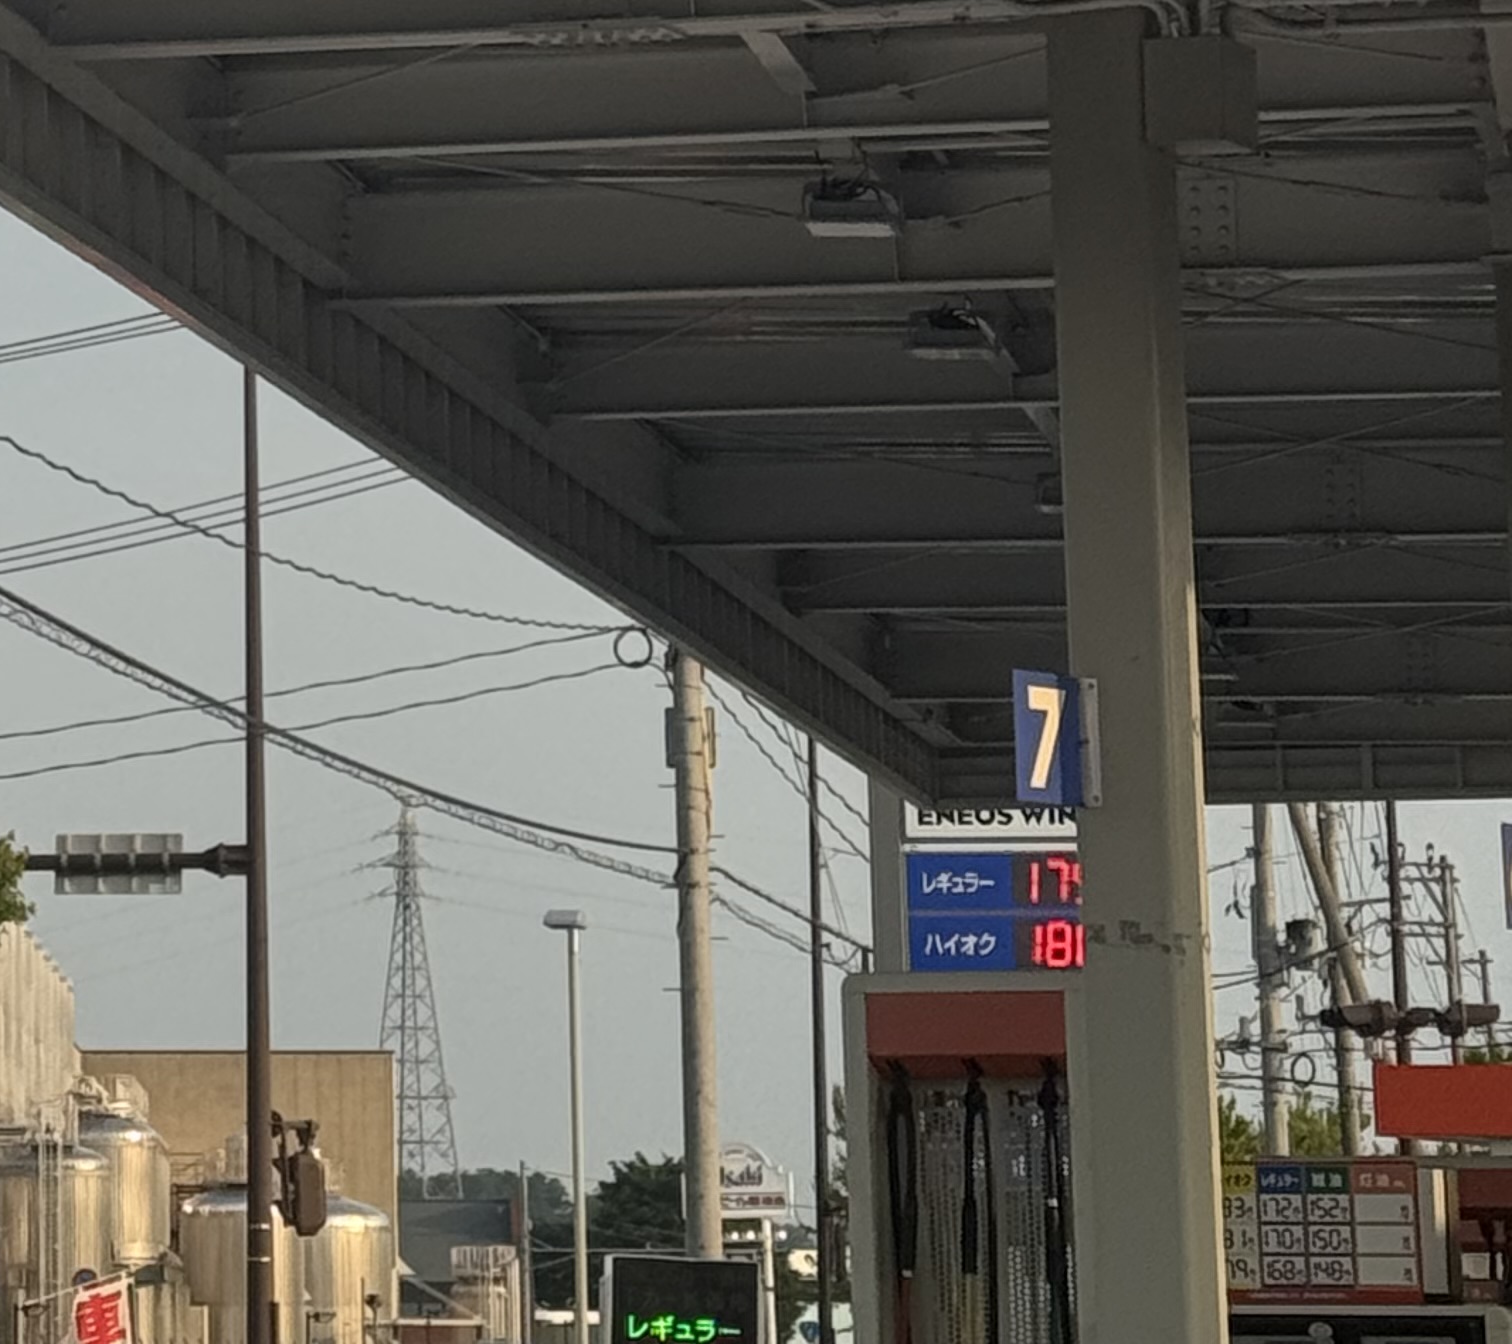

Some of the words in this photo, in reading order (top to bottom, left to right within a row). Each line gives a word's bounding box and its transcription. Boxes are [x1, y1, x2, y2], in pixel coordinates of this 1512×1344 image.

[1027, 684, 1066, 789] 7
[918, 808, 1014, 826] ENEOS
[922, 871, 996, 895] レギュラー
[924, 933, 997, 956] ハイオク
[629, 1315, 741, 1342] レギュラー
